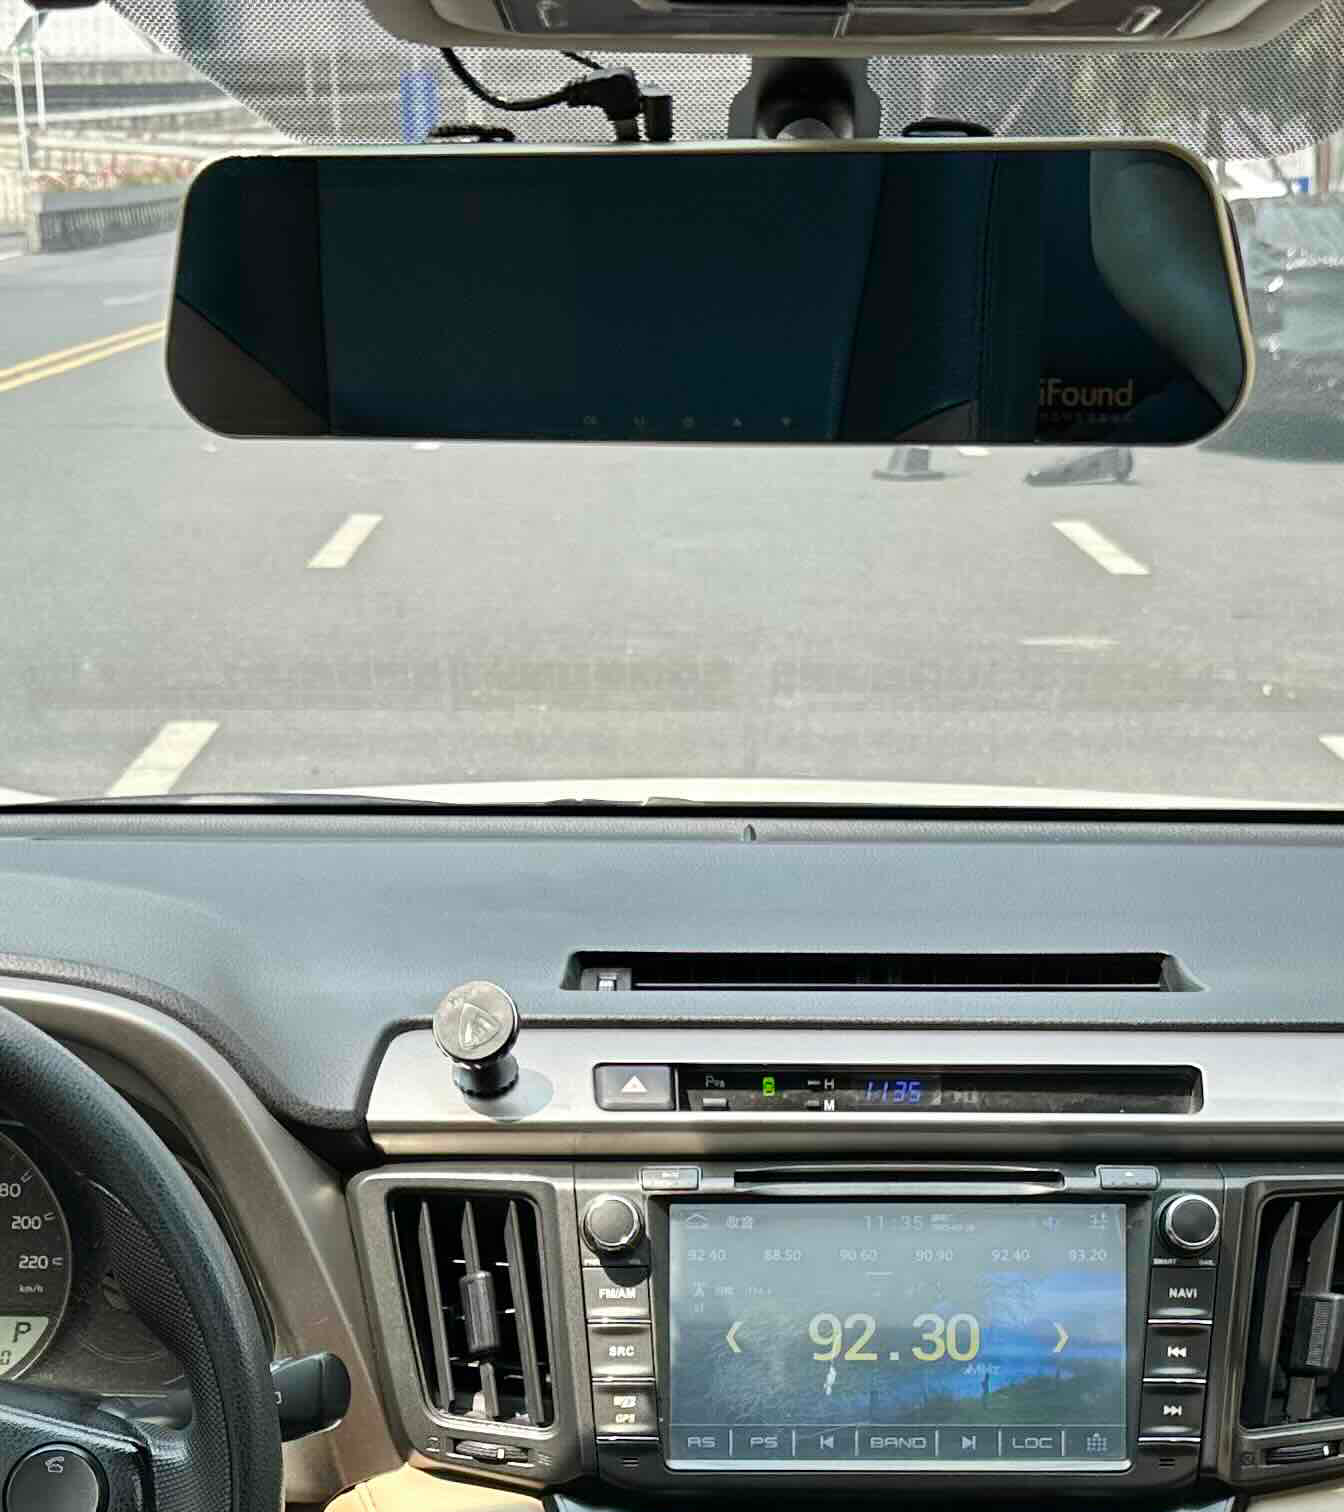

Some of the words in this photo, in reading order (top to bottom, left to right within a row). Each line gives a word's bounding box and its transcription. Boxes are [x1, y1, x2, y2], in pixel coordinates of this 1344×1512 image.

[824, 1099, 835, 1111] M
[11, 1215, 42, 1231] 200
[18, 1255, 48, 1270] 220
[1168, 1287, 1198, 1298] NAVI
[12, 1321, 32, 1343] P
[808, 1312, 981, 1362] 92.30
[608, 1345, 635, 1357] SRC
[749, 1436, 780, 1448] PS
[870, 1436, 927, 1448] BAND
[1011, 1436, 1054, 1448] LOC
